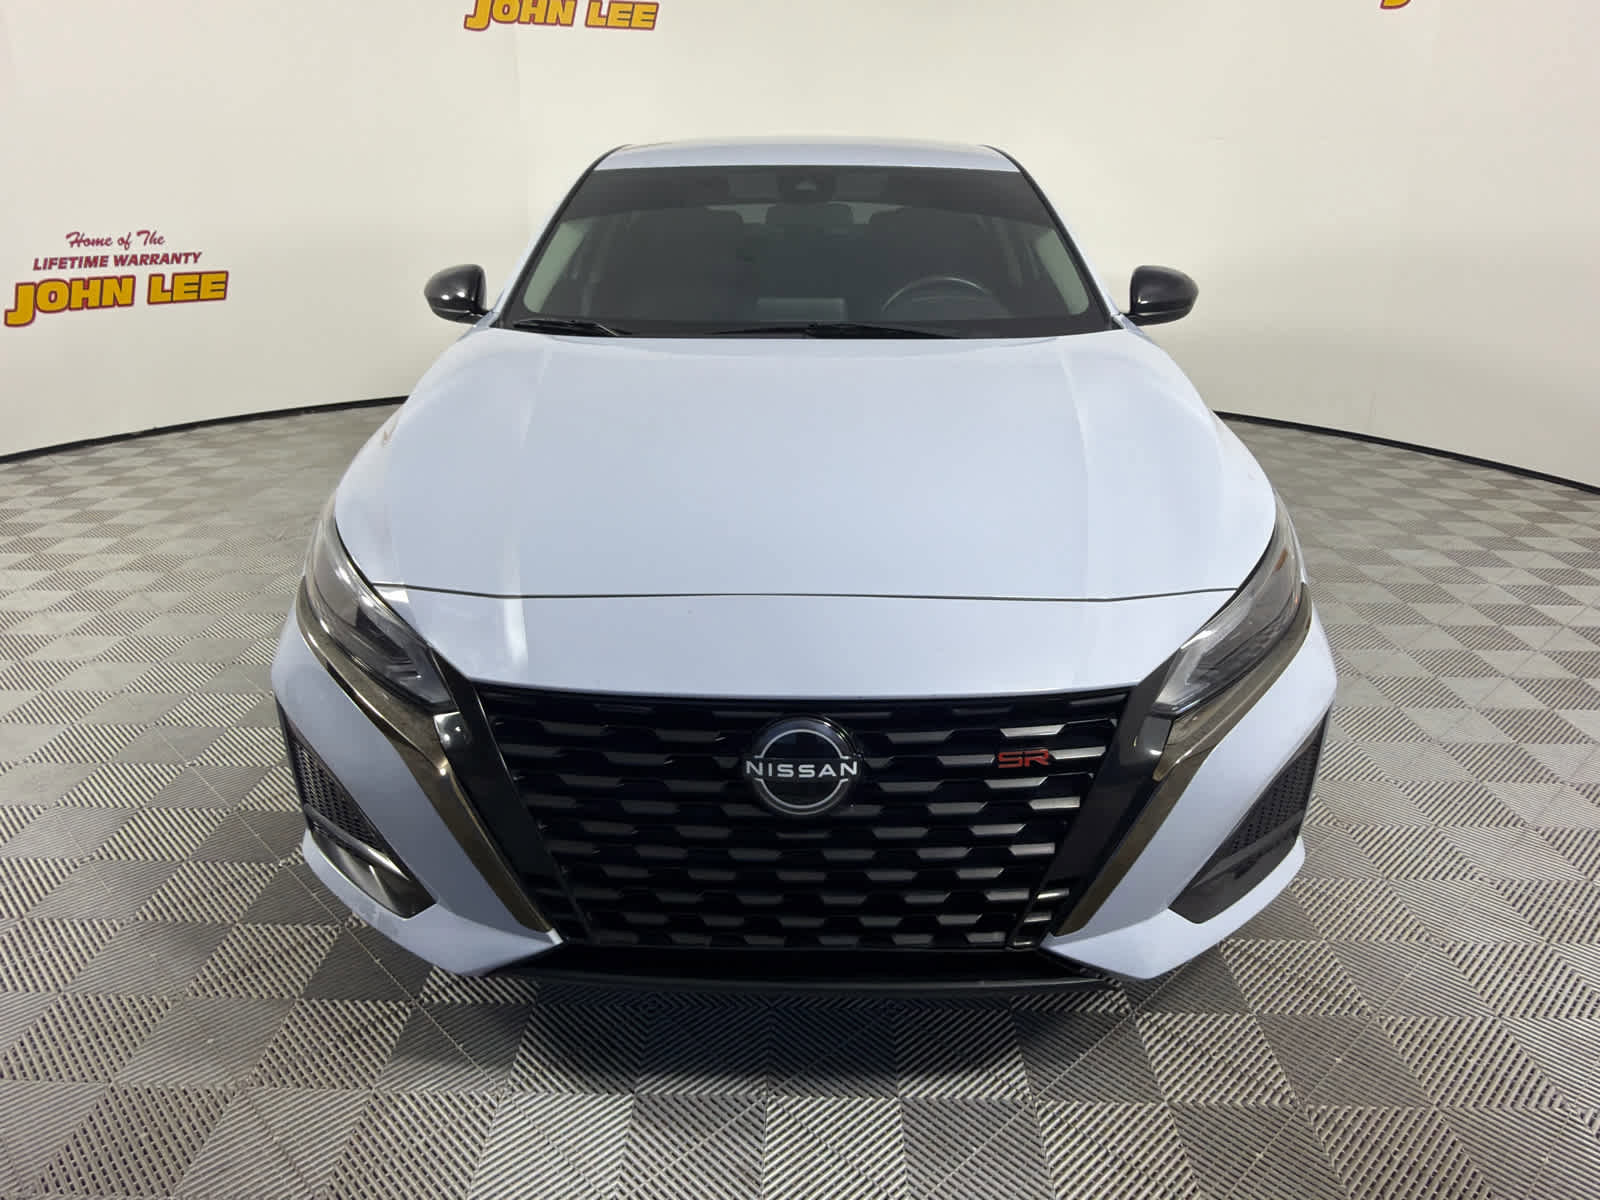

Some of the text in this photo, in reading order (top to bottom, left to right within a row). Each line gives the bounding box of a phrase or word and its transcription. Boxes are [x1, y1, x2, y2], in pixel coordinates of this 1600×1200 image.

[464, 0, 659, 31] JOHN LEE
[66, 230, 165, 250] Home of The
[33, 251, 202, 271] LIFETIME WARRANTY
[4, 270, 229, 327] JOHN LEE
[745, 760, 858, 778] NISSAN
[997, 749, 1049, 769] SR
